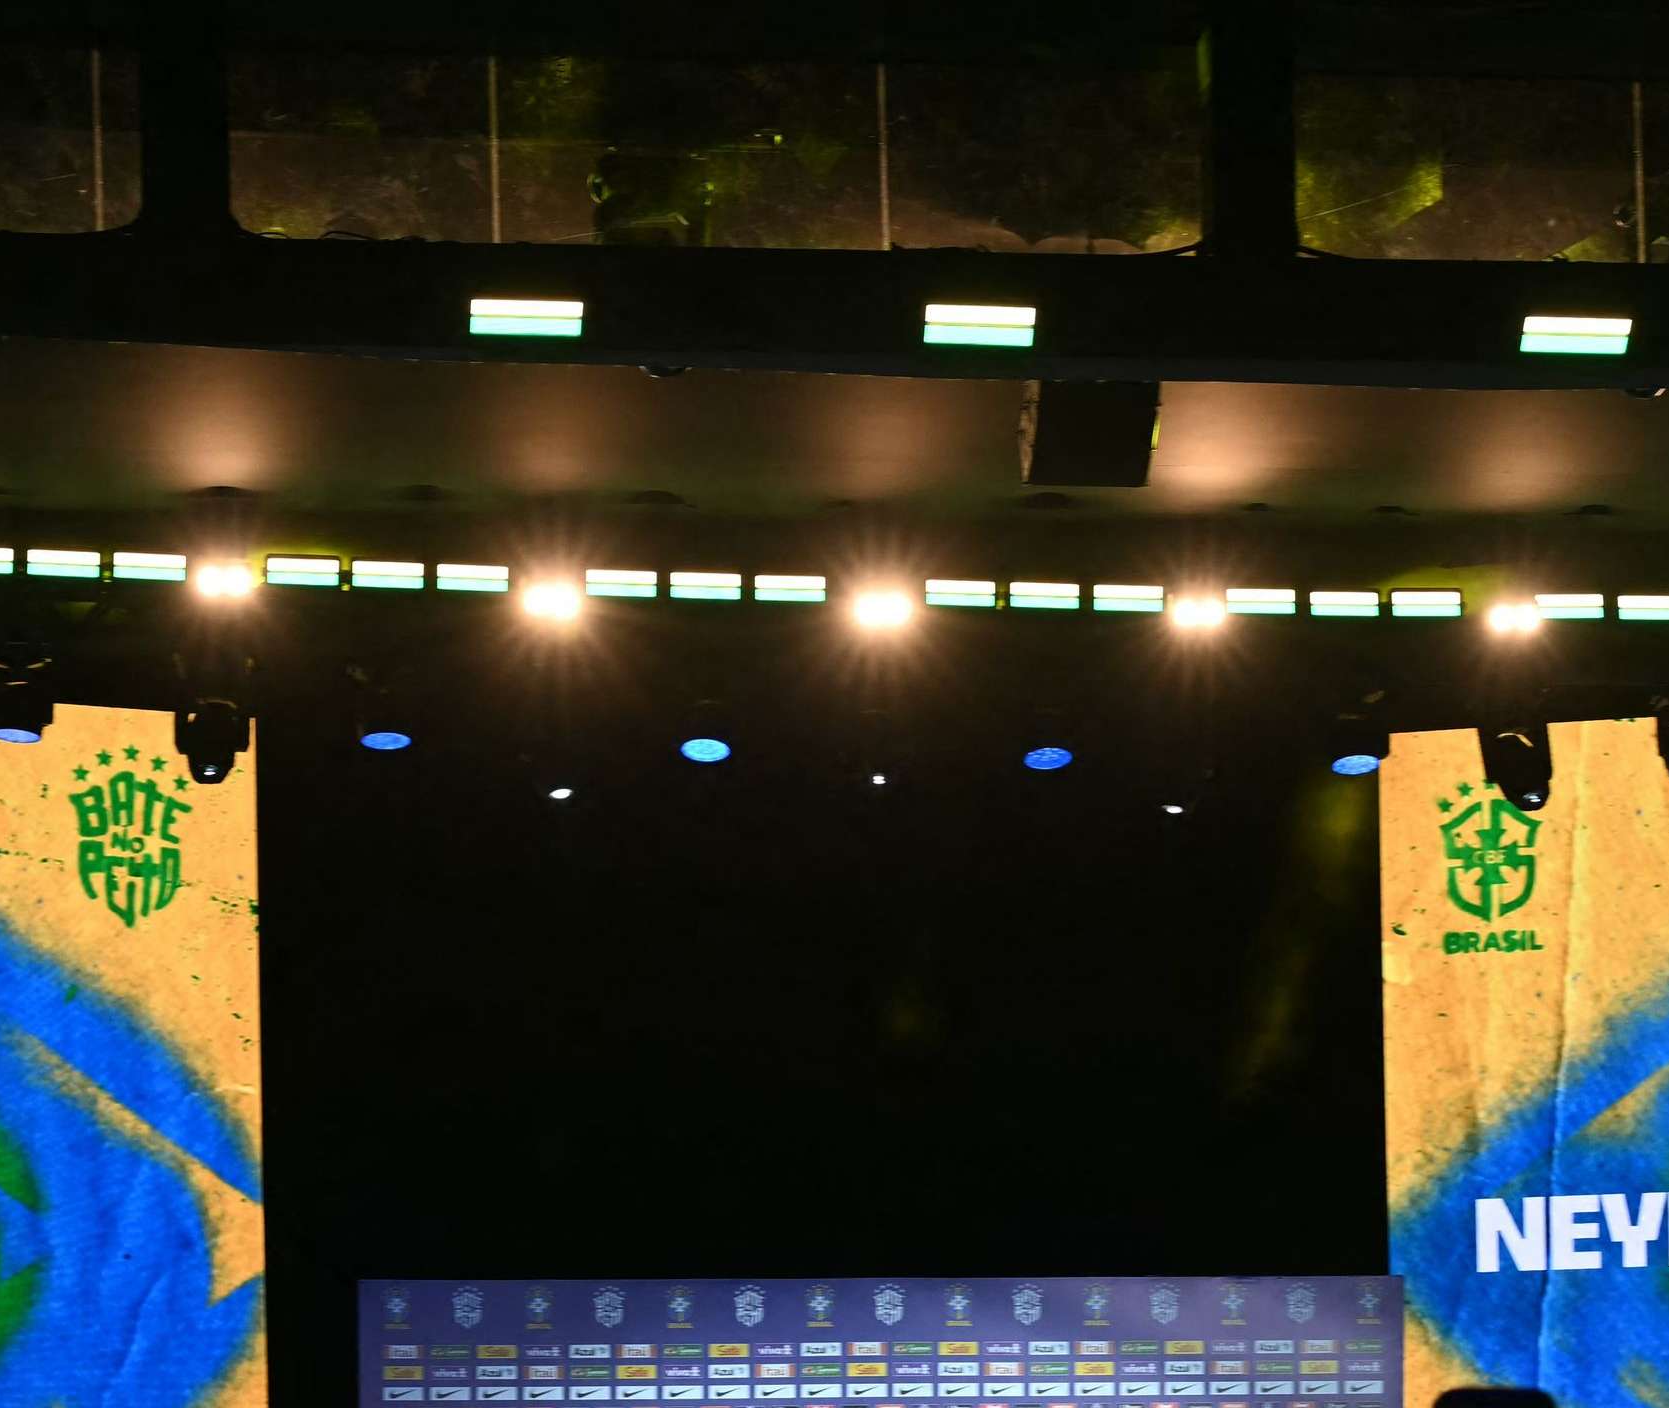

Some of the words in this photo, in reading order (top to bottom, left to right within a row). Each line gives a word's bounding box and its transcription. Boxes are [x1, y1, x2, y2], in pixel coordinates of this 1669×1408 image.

[68, 771, 193, 844] BATE
[111, 829, 144, 854] NO
[1442, 930, 1544, 955] BRASIL
